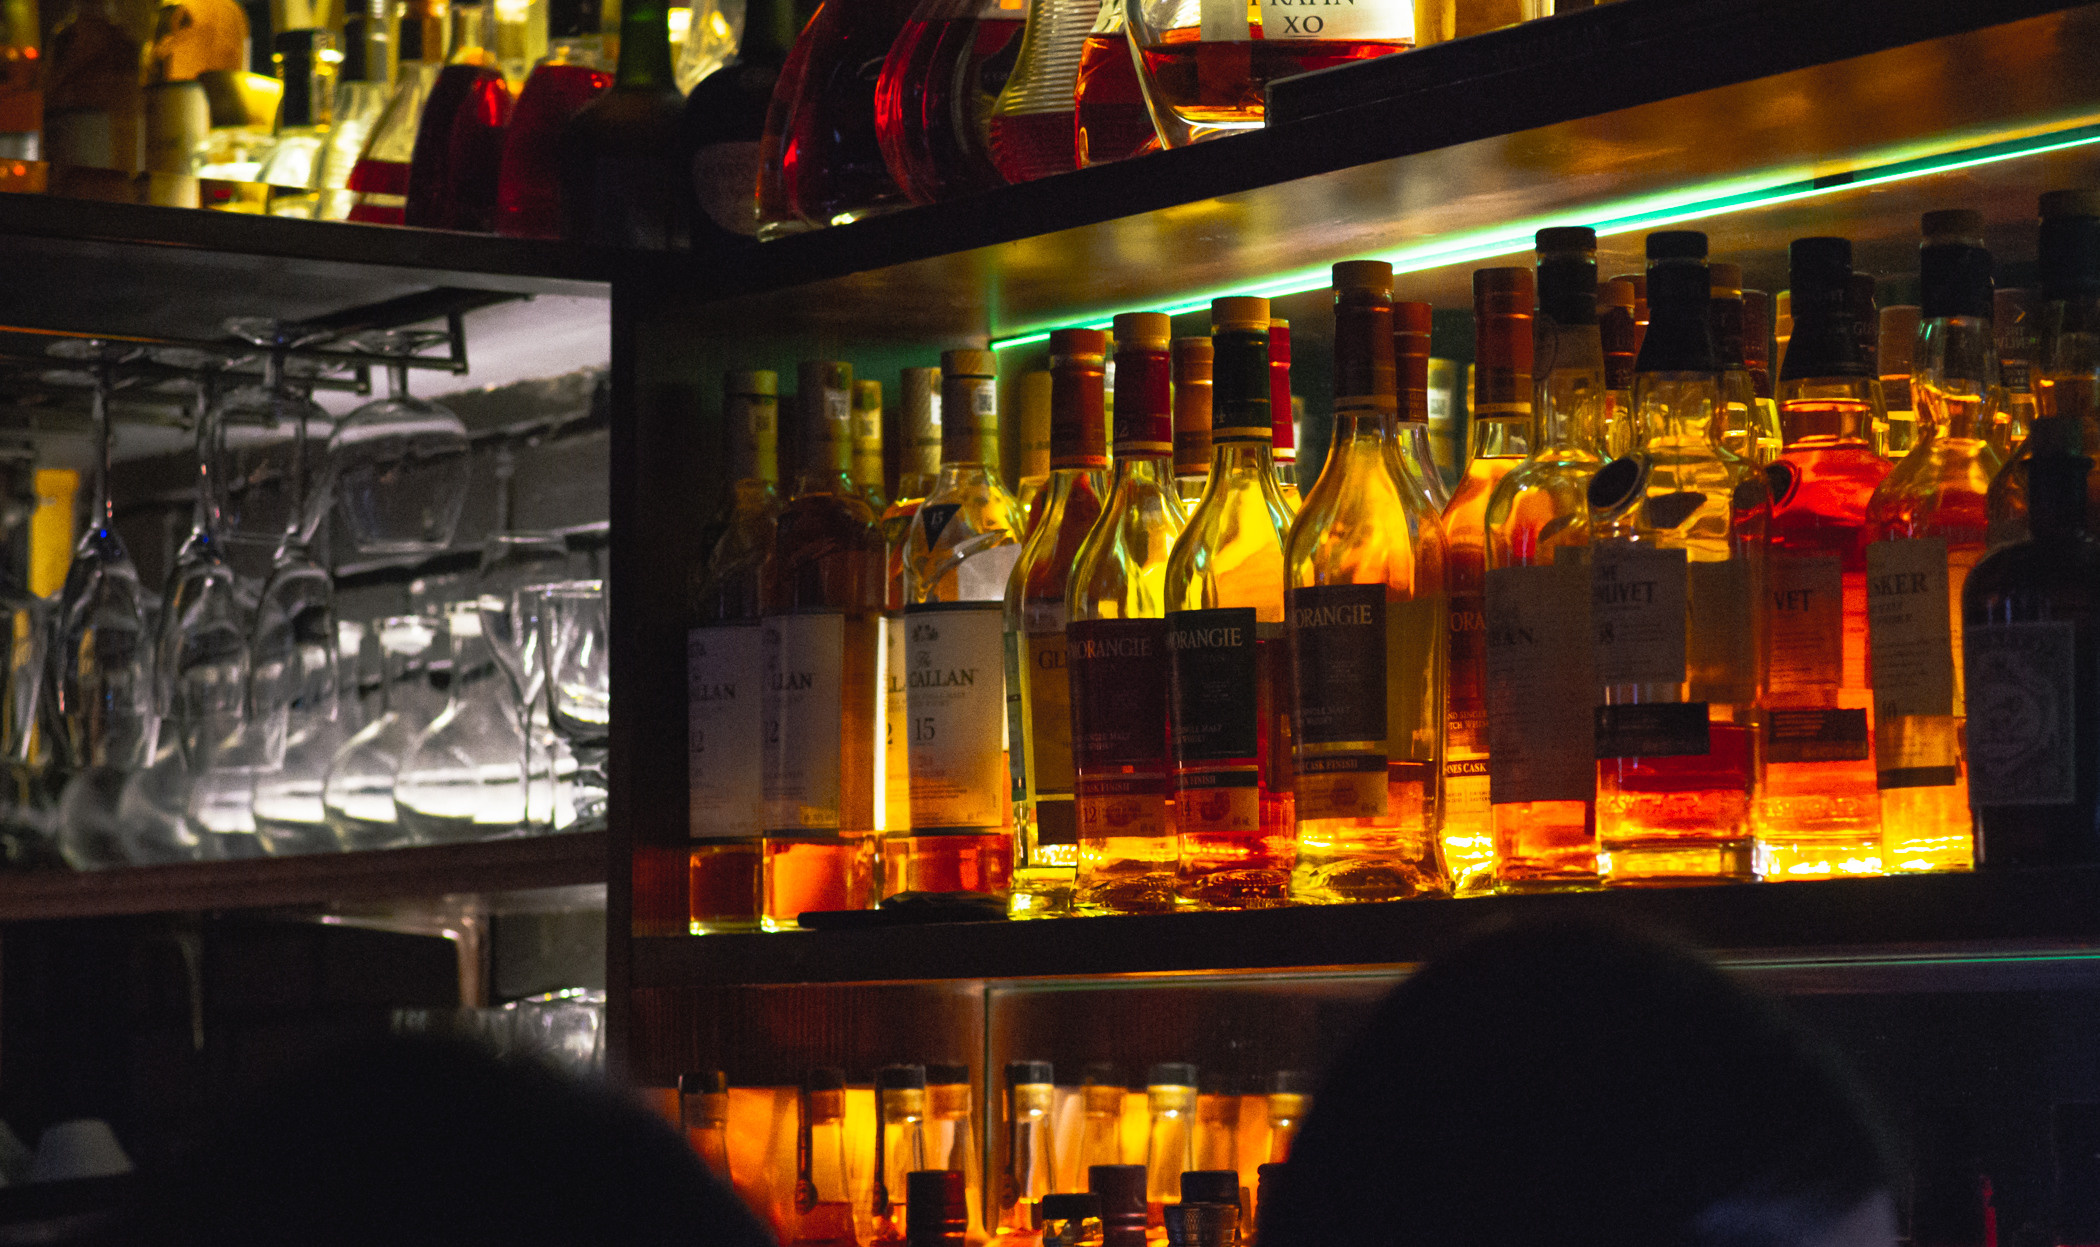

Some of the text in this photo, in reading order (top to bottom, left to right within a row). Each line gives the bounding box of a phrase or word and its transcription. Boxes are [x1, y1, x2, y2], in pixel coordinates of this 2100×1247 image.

[1283, 15, 1324, 34] XO
[914, 717, 936, 741] 15
[1463, 762, 1488, 774] CASK
